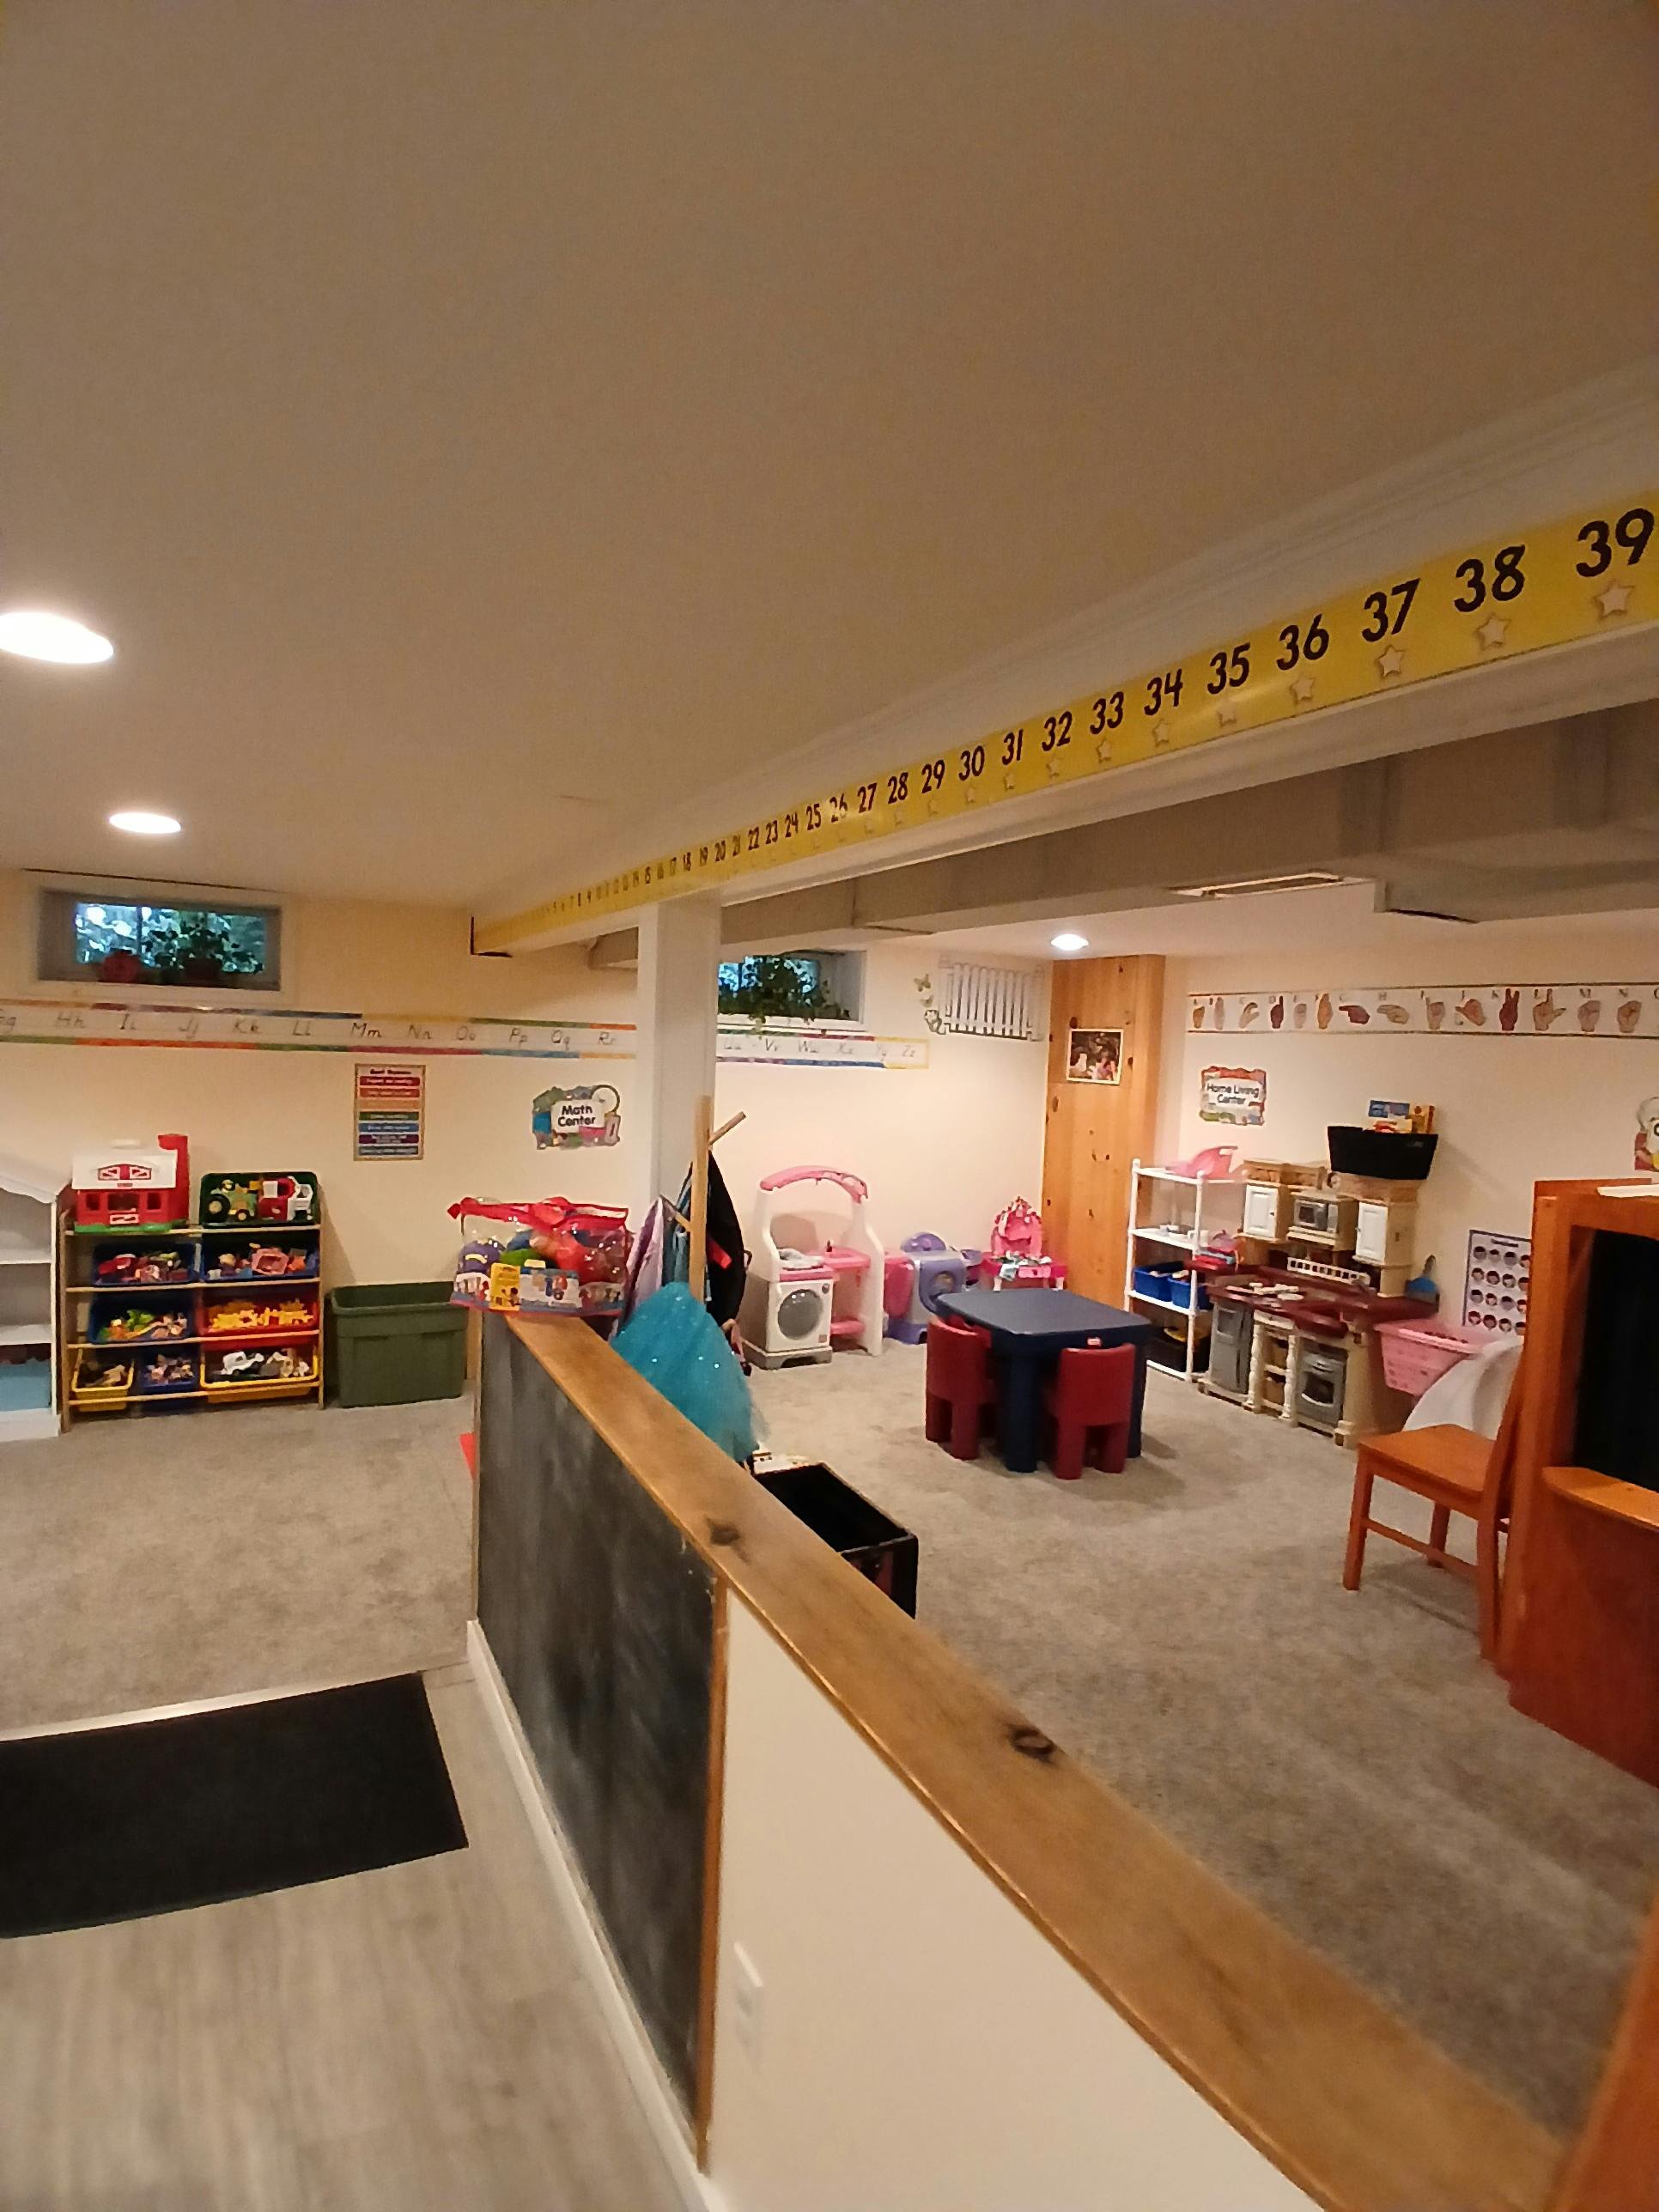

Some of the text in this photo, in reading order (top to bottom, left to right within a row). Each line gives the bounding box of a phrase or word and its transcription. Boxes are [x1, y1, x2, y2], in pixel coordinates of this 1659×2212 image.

[714, 840, 726, 862] 20
[748, 827, 760, 850] 22
[765, 820, 778, 844] 23
[785, 812, 799, 837] 24
[806, 803, 822, 830] 25
[830, 793, 848, 823] 26
[857, 782, 878, 813] 27
[887, 772, 909, 805] 28
[921, 760, 945, 793] 29
[958, 745, 985, 781] 30
[1001, 729, 1024, 766] 31
[1042, 711, 1073, 751] 32
[1090, 691, 1124, 734] 33
[1144, 668, 1183, 716] 34
[1206, 642, 1251, 695] 35
[1276, 614, 1330, 671] 36
[1361, 577, 1422, 642] 37
[1453, 544, 1526, 613] 38
[1575, 507, 1656, 577] 39
[350, 1022, 382, 1038] Mm
[407, 1024, 432, 1040] Nn
[456, 1025, 477, 1042] Oo
[509, 1027, 528, 1048] Pp
[1207, 1083, 1232, 1094] Home
[558, 1115, 596, 1127] Center
